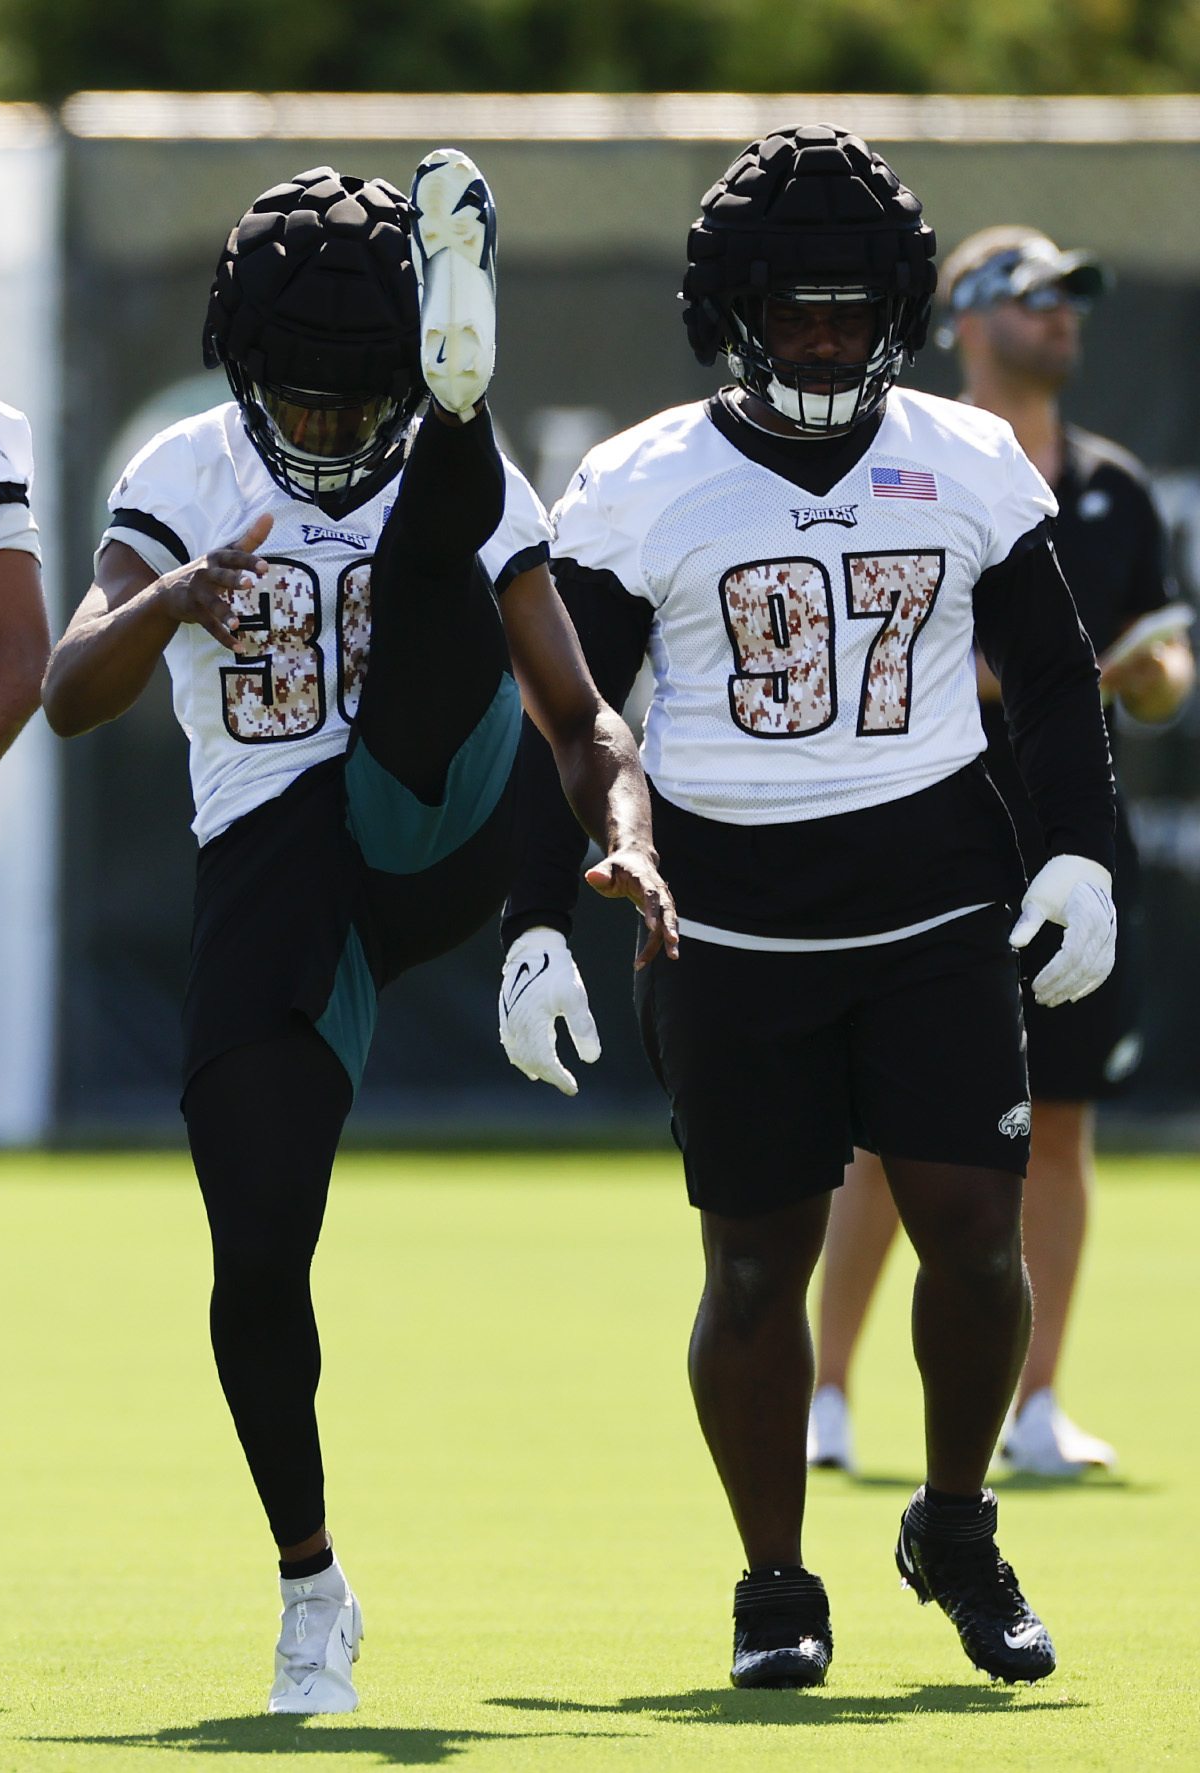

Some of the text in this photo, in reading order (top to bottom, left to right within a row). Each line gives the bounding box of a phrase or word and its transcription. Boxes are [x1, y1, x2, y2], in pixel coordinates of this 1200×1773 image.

[789, 504, 858, 532] EAGLES
[301, 524, 370, 550] EAGLES
[719, 548, 945, 739] 97
